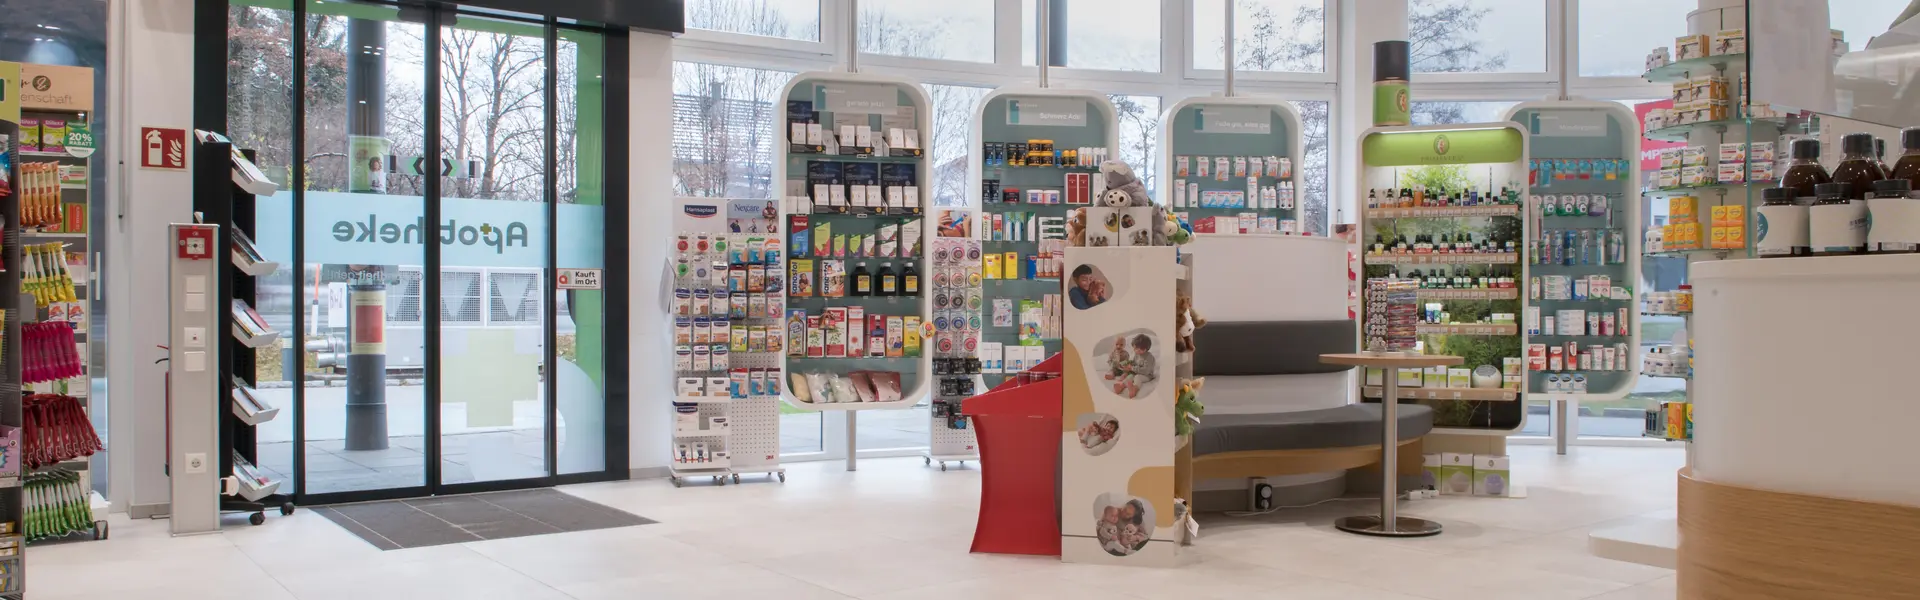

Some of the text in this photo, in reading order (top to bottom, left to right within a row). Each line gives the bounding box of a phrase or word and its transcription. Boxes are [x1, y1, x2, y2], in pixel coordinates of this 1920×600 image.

[20, 92, 73, 105] enschaft
[686, 206, 716, 214] Hansaplast
[734, 203, 760, 213] Nexcare
[575, 270, 596, 278] Kauft
